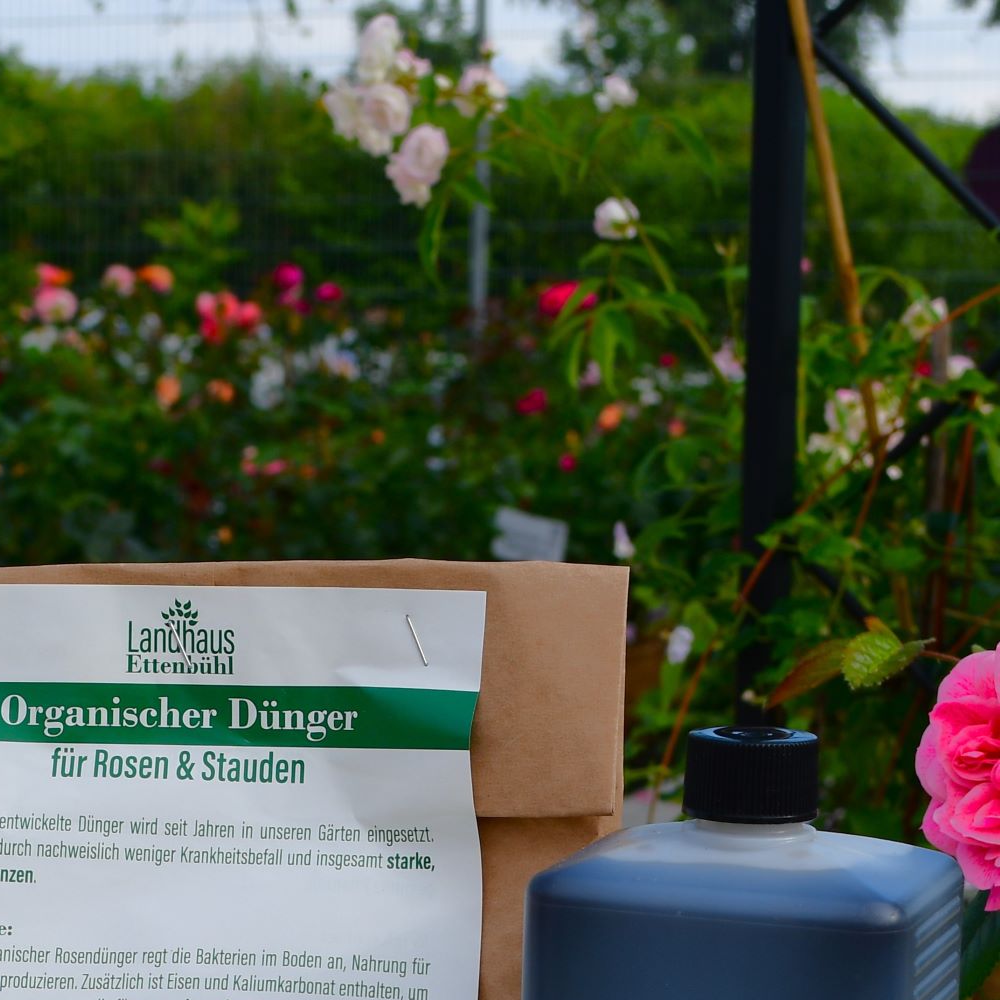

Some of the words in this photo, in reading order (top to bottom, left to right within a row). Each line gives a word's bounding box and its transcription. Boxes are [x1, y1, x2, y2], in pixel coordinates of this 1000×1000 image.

[128, 620, 235, 655] Landhaus
[126, 654, 234, 675] Ettenbühl
[1, 694, 217, 737] Organischer
[228, 697, 358, 742] Dünger
[51, 748, 88, 779] für
[94, 751, 168, 782] Rosen
[177, 752, 195, 782] &
[202, 750, 305, 784] Stauden
[78, 814, 123, 837] Dünger
[130, 817, 158, 835] wird
[164, 818, 187, 836] seit
[193, 819, 234, 838] Jahren
[241, 820, 253, 839] in
[260, 825, 311, 840] unseren
[318, 823, 360, 841] Gärten
[367, 823, 433, 846] eingesetzt.
[36, 840, 119, 860] nachweislich
[124, 844, 175, 866] weniger
[180, 845, 282, 865] Krankheitsbefall
[287, 848, 311, 865] und
[316, 849, 383, 870] insgesamt
[386, 851, 434, 871] starke,
[54, 946, 137, 968] Rosendünger
[141, 948, 167, 967] regt
[170, 947, 190, 964] die
[195, 948, 256, 966] Bakterien
[261, 950, 276, 966] im
[282, 951, 321, 968] Boden
[327, 956, 346, 972] an,
[351, 954, 406, 977] Nahrung
[412, 957, 430, 975] für
